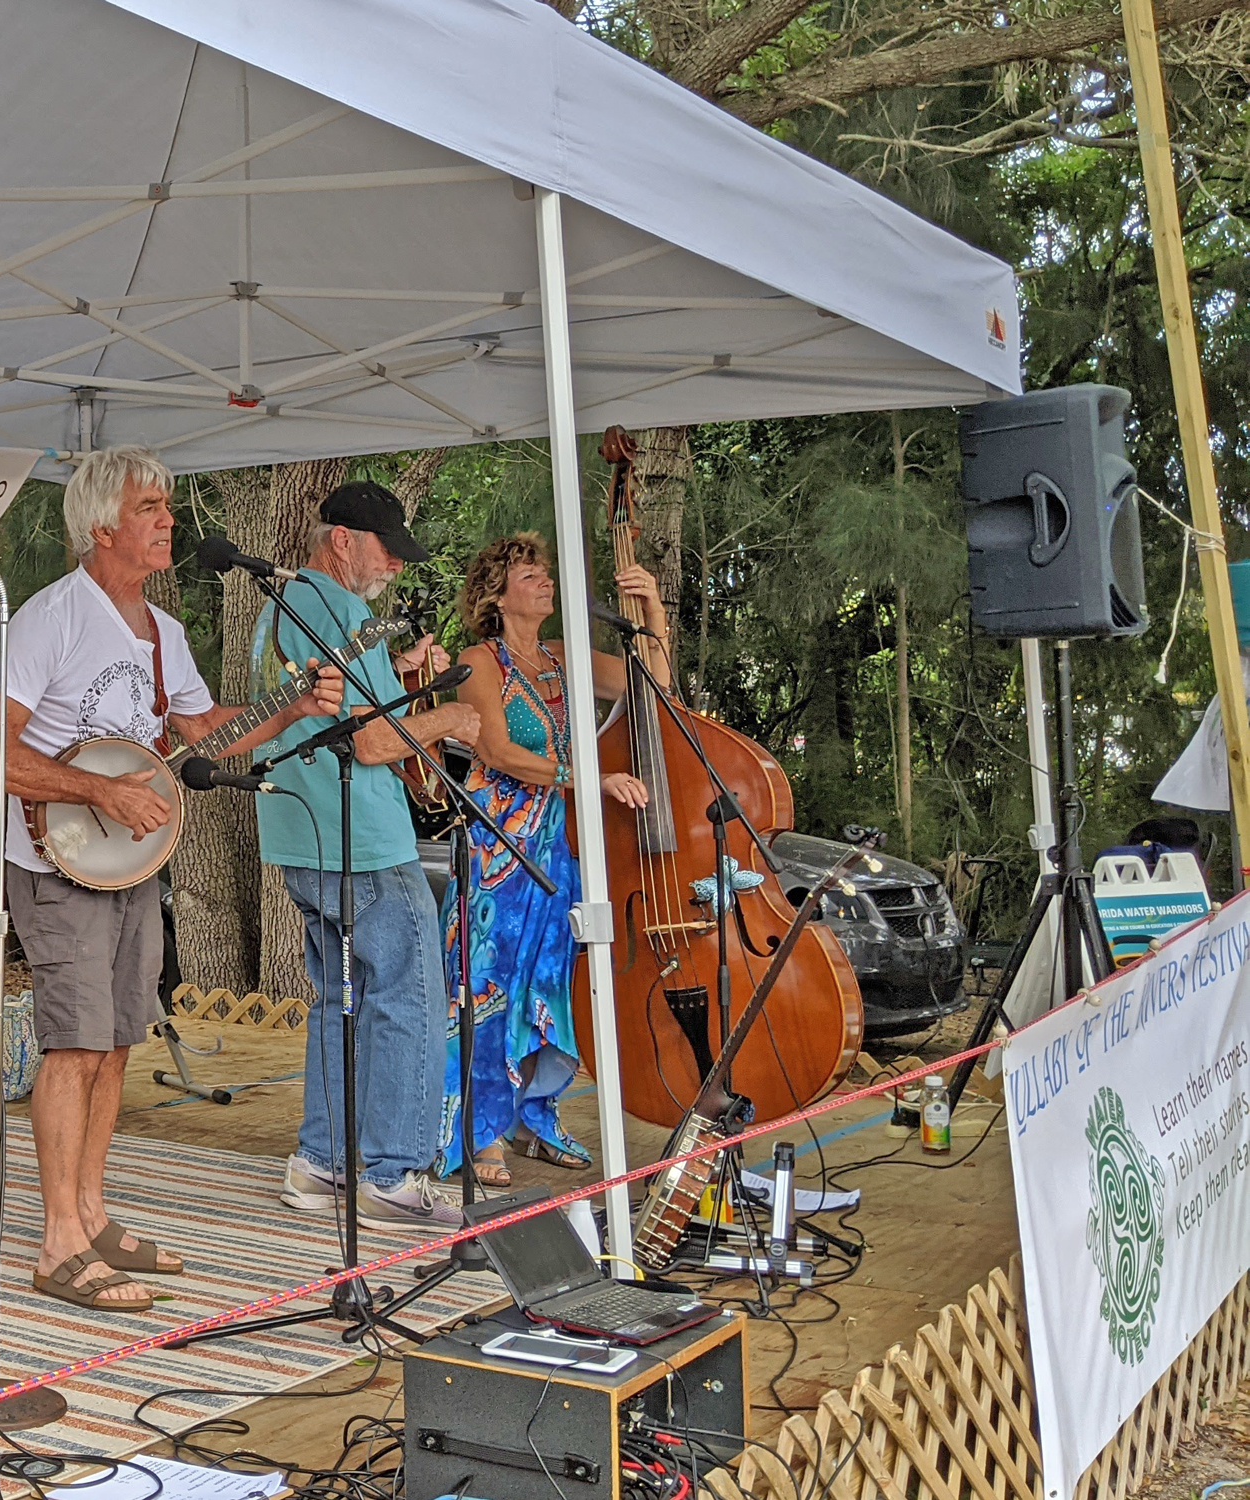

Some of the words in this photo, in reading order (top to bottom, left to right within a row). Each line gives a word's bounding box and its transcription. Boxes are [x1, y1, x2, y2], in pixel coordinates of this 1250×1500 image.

[1124, 905, 1156, 918] WATER
[1156, 903, 1204, 916] WARRIORS
[342, 935, 350, 982] SAMSON
[1010, 1029, 1073, 1137] LULLABY
[1076, 1012, 1102, 1074] OF
[1104, 989, 1135, 1054] THE
[1135, 953, 1190, 1031] RIVERS
[1085, 1086, 1126, 1148] WATER
[1152, 1091, 1189, 1138] Learn
[1186, 1064, 1214, 1110] their
[1214, 1040, 1249, 1088] names
[1167, 1138, 1193, 1187] Tell
[1193, 1119, 1220, 1167] their
[1219, 1091, 1250, 1141] stories
[1175, 1192, 1204, 1240] Keep
[1204, 1167, 1230, 1209] them
[1100, 1235, 1165, 1368] PROTECTOR
